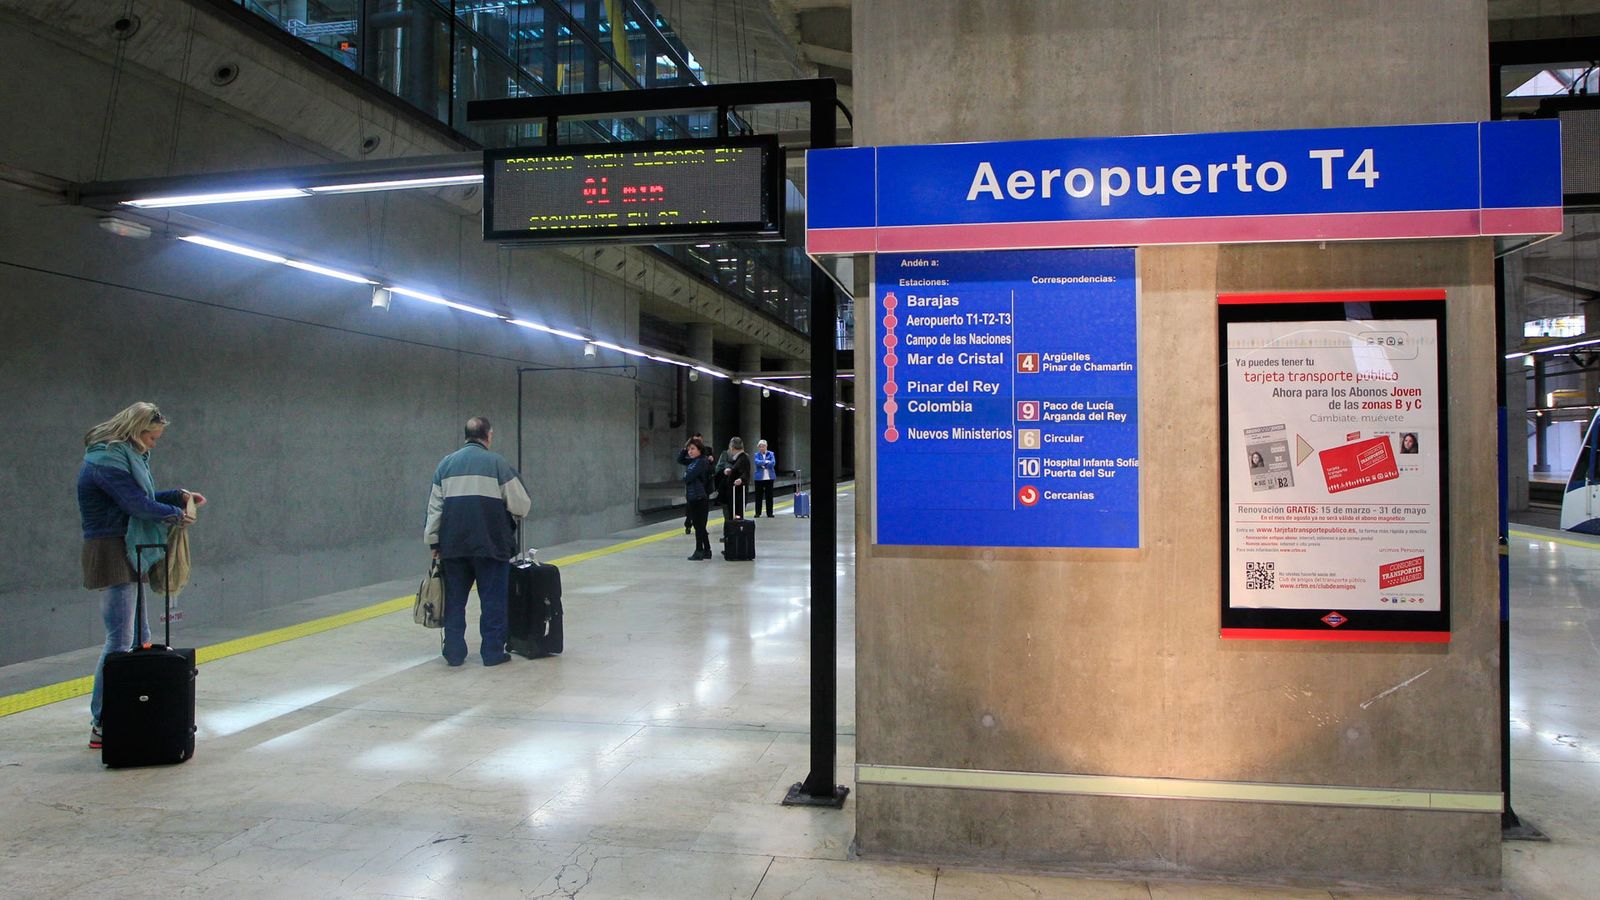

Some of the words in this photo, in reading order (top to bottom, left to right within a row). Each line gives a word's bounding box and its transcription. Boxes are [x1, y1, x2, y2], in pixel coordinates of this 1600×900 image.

[967, 154, 1288, 207] Aeropuerto
[1309, 148, 1380, 190] T4
[900, 258, 929, 267] Andén
[930, 259, 939, 267] a:
[899, 278, 950, 287] Estaciones:
[1031, 274, 1117, 285] Correspondencias:
[907, 294, 960, 309] Barajas
[906, 314, 964, 329] Aeropuerto
[966, 312, 1011, 326] T1-T2-T3
[905, 333, 938, 348] Campo
[939, 333, 952, 345] de
[953, 333, 967, 345] las
[969, 332, 1012, 345] Naciones
[907, 353, 934, 365] Mar
[937, 352, 954, 365] de
[958, 352, 1004, 365] Cristal
[1022, 355, 1035, 371] 4
[1043, 352, 1091, 363] Argüelles
[1235, 358, 1247, 366] Ya
[1249, 358, 1279, 368] puedes
[1281, 358, 1304, 366] tener
[1305, 358, 1315, 366] tu
[1043, 362, 1068, 372] Pinar
[1070, 362, 1082, 372] de
[1084, 361, 1133, 372] Chamartín
[1244, 371, 1285, 384] tarjeta
[1288, 371, 1353, 384] transporte
[1356, 371, 1399, 384] público
[907, 380, 945, 393] Pinar
[948, 380, 969, 393] del
[972, 380, 1000, 395] Rey
[1272, 387, 1302, 398] Ahora
[1305, 389, 1328, 399] para
[1331, 387, 1347, 398] los
[1349, 386, 1388, 397] Abonos
[1390, 386, 1422, 397] Joven
[907, 400, 973, 413] Colombia
[1043, 401, 1069, 411] Paco
[1071, 401, 1084, 411] de
[1086, 401, 1114, 411] Lucía
[1328, 399, 1341, 410] de
[1344, 399, 1359, 410] las
[1361, 401, 1393, 410] zonas
[1395, 399, 1403, 409] B
[1405, 401, 1411, 411] y
[1414, 399, 1422, 409] C
[1022, 403, 1035, 420] 9
[1043, 411, 1086, 423] Arganda
[1088, 411, 1105, 421] del
[1107, 411, 1127, 423] Rey
[1360, 413, 1404, 423] muévete
[907, 427, 949, 440] Nuevos
[952, 427, 1013, 440] Ministerios
[1023, 431, 1036, 447] 6
[1043, 433, 1085, 443] Circular
[1019, 459, 1039, 476] 10
[1043, 458, 1081, 469] Hospital
[1083, 457, 1115, 468] Infanta
[1116, 457, 1139, 468] Sofía
[1043, 468, 1077, 478] Puerta
[1079, 468, 1095, 478] del
[1097, 468, 1116, 478] Sur
[1043, 490, 1095, 500] Cercanías
[1238, 506, 1284, 514] Renovación
[1286, 506, 1319, 514] GRATIS:
[1321, 506, 1331, 514] 15
[1333, 506, 1343, 514] de
[1345, 506, 1371, 514] marzo
[1379, 506, 1389, 514] 31
[1391, 506, 1402, 514] de
[1403, 507, 1427, 516] mayo
